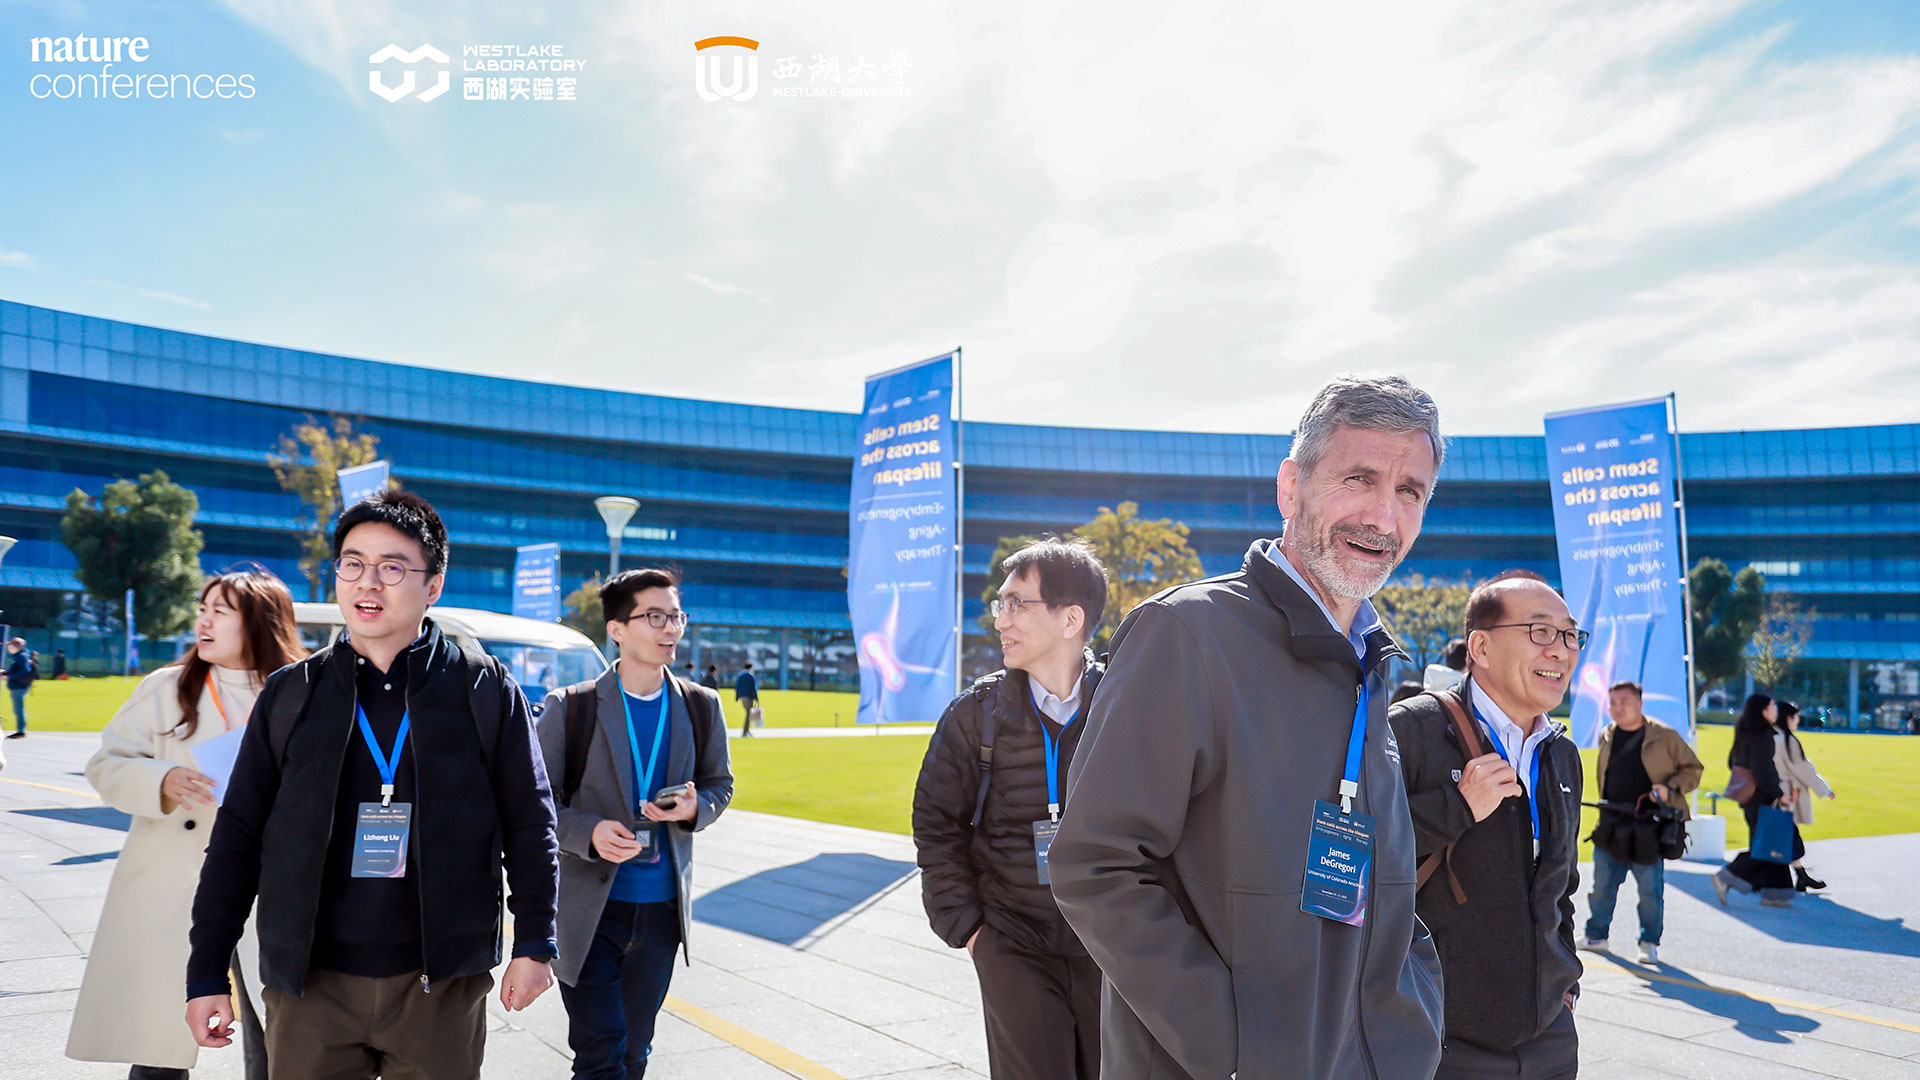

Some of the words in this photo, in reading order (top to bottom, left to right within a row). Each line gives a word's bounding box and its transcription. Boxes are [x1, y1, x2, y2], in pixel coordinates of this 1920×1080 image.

[1328, 846, 1350, 861] James
[1320, 856, 1356, 874] DeGregori
[1308, 869, 1326, 879] University
[1331, 875, 1347, 885] Colorado
